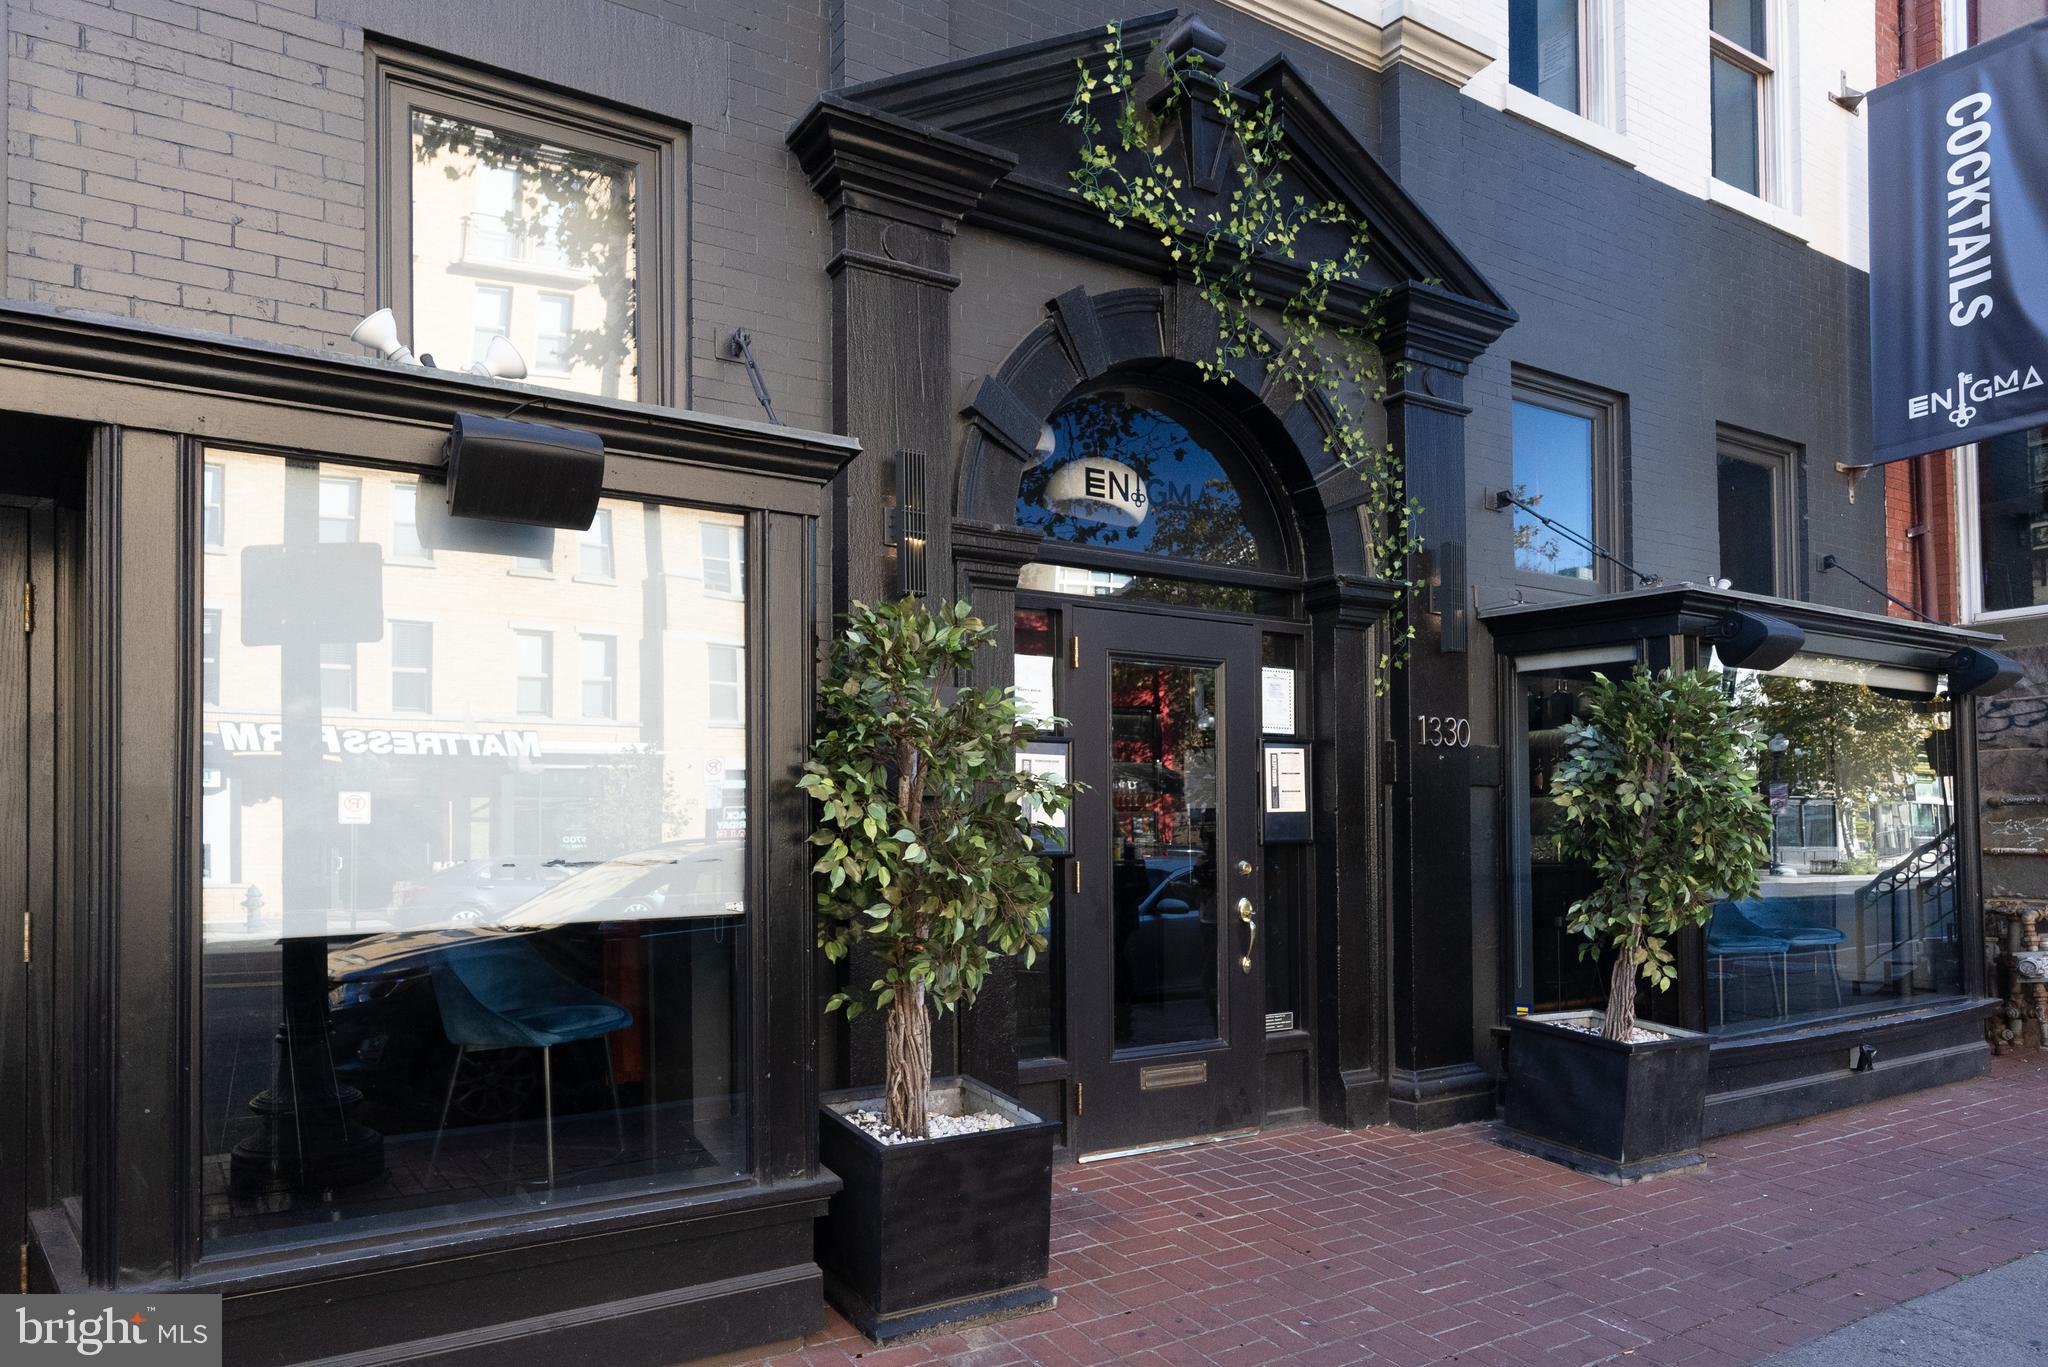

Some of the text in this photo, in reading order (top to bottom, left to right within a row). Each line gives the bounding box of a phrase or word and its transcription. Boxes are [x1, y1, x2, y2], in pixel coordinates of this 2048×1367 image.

[1945, 92, 1994, 328] COCKTAILS
[1908, 365, 2044, 427] ENIGMA
[1417, 714, 1471, 748] 1330
